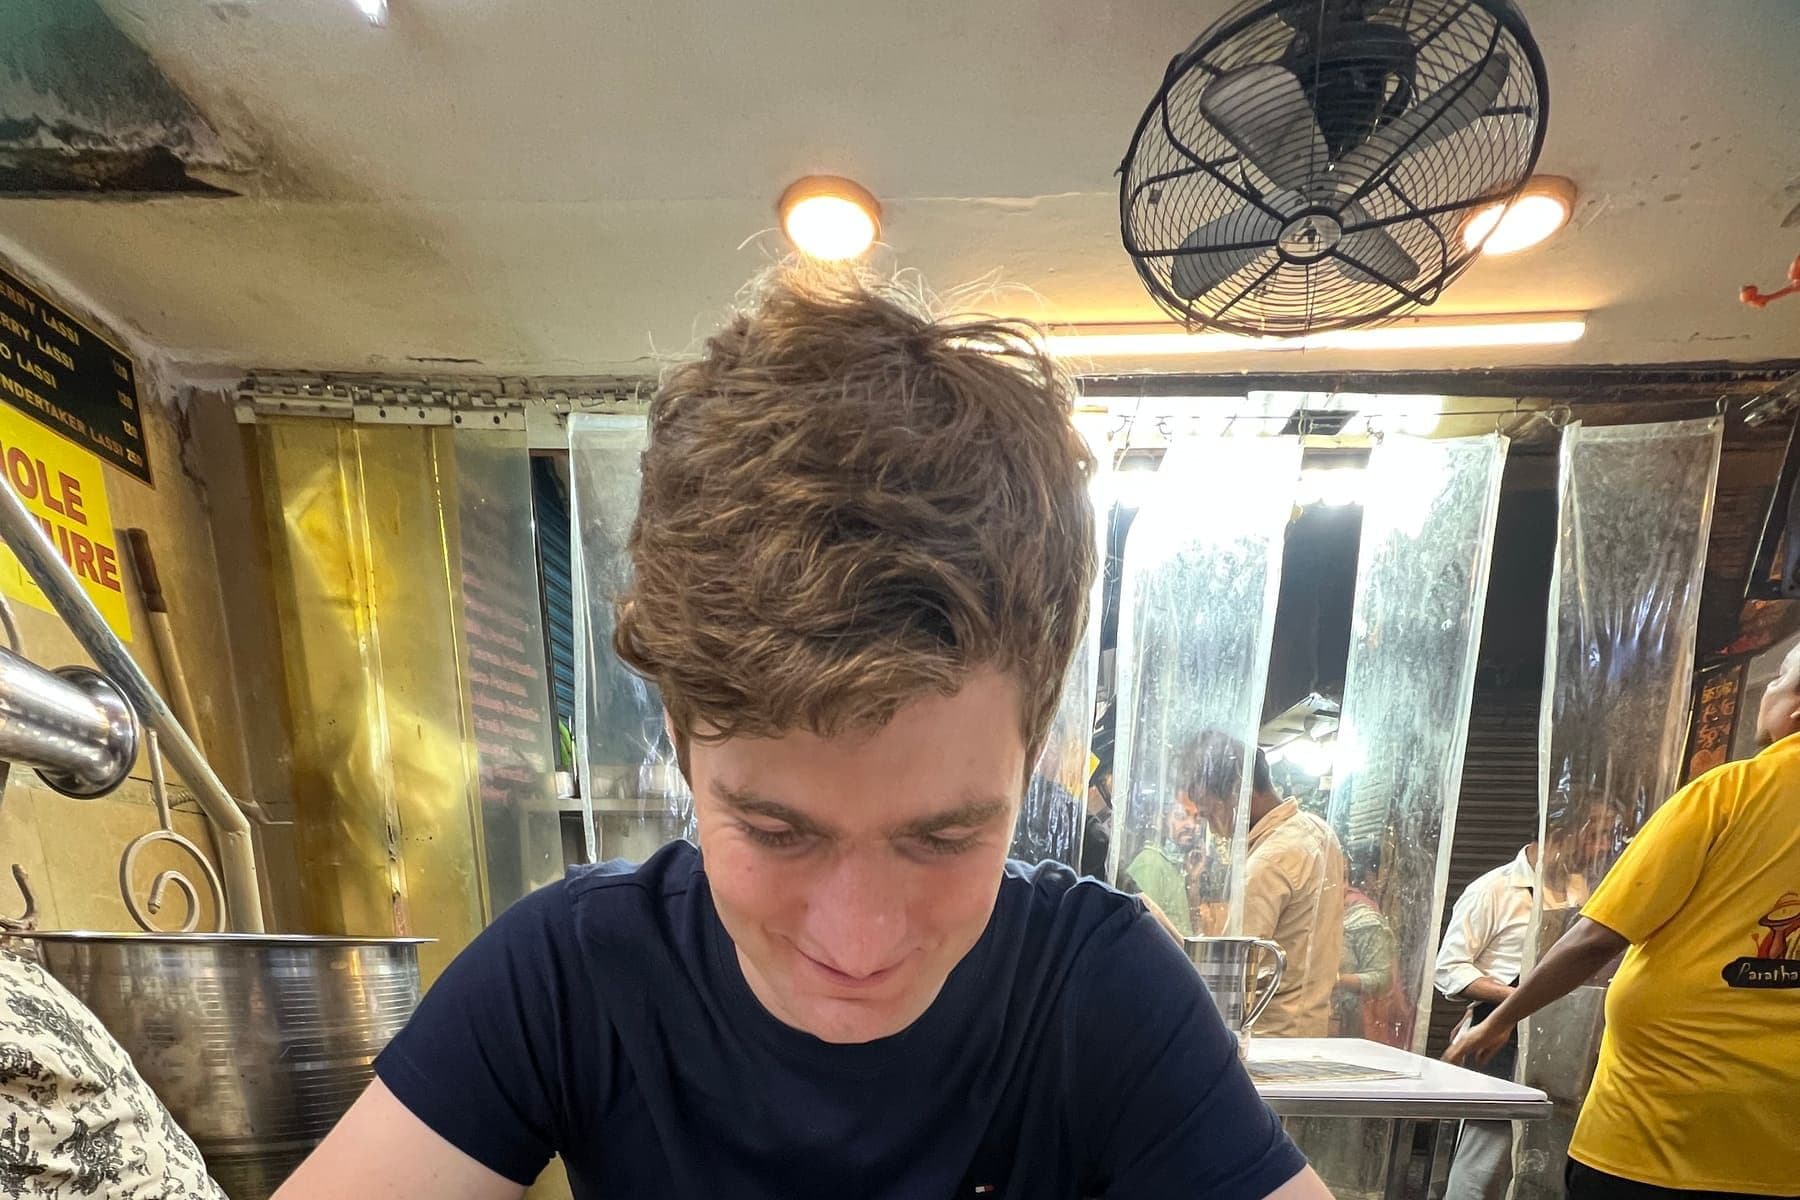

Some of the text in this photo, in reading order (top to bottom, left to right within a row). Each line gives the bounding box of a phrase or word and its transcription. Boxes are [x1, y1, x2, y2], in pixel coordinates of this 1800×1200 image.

[0, 312, 30, 342] RRY
[35, 334, 75, 371] LASSI
[41, 308, 79, 346] LASSI
[16, 351, 57, 390] LASSI
[0, 373, 87, 437] NDERTAKER
[89, 426, 124, 456] LASSI
[30, 511, 121, 593] URE
